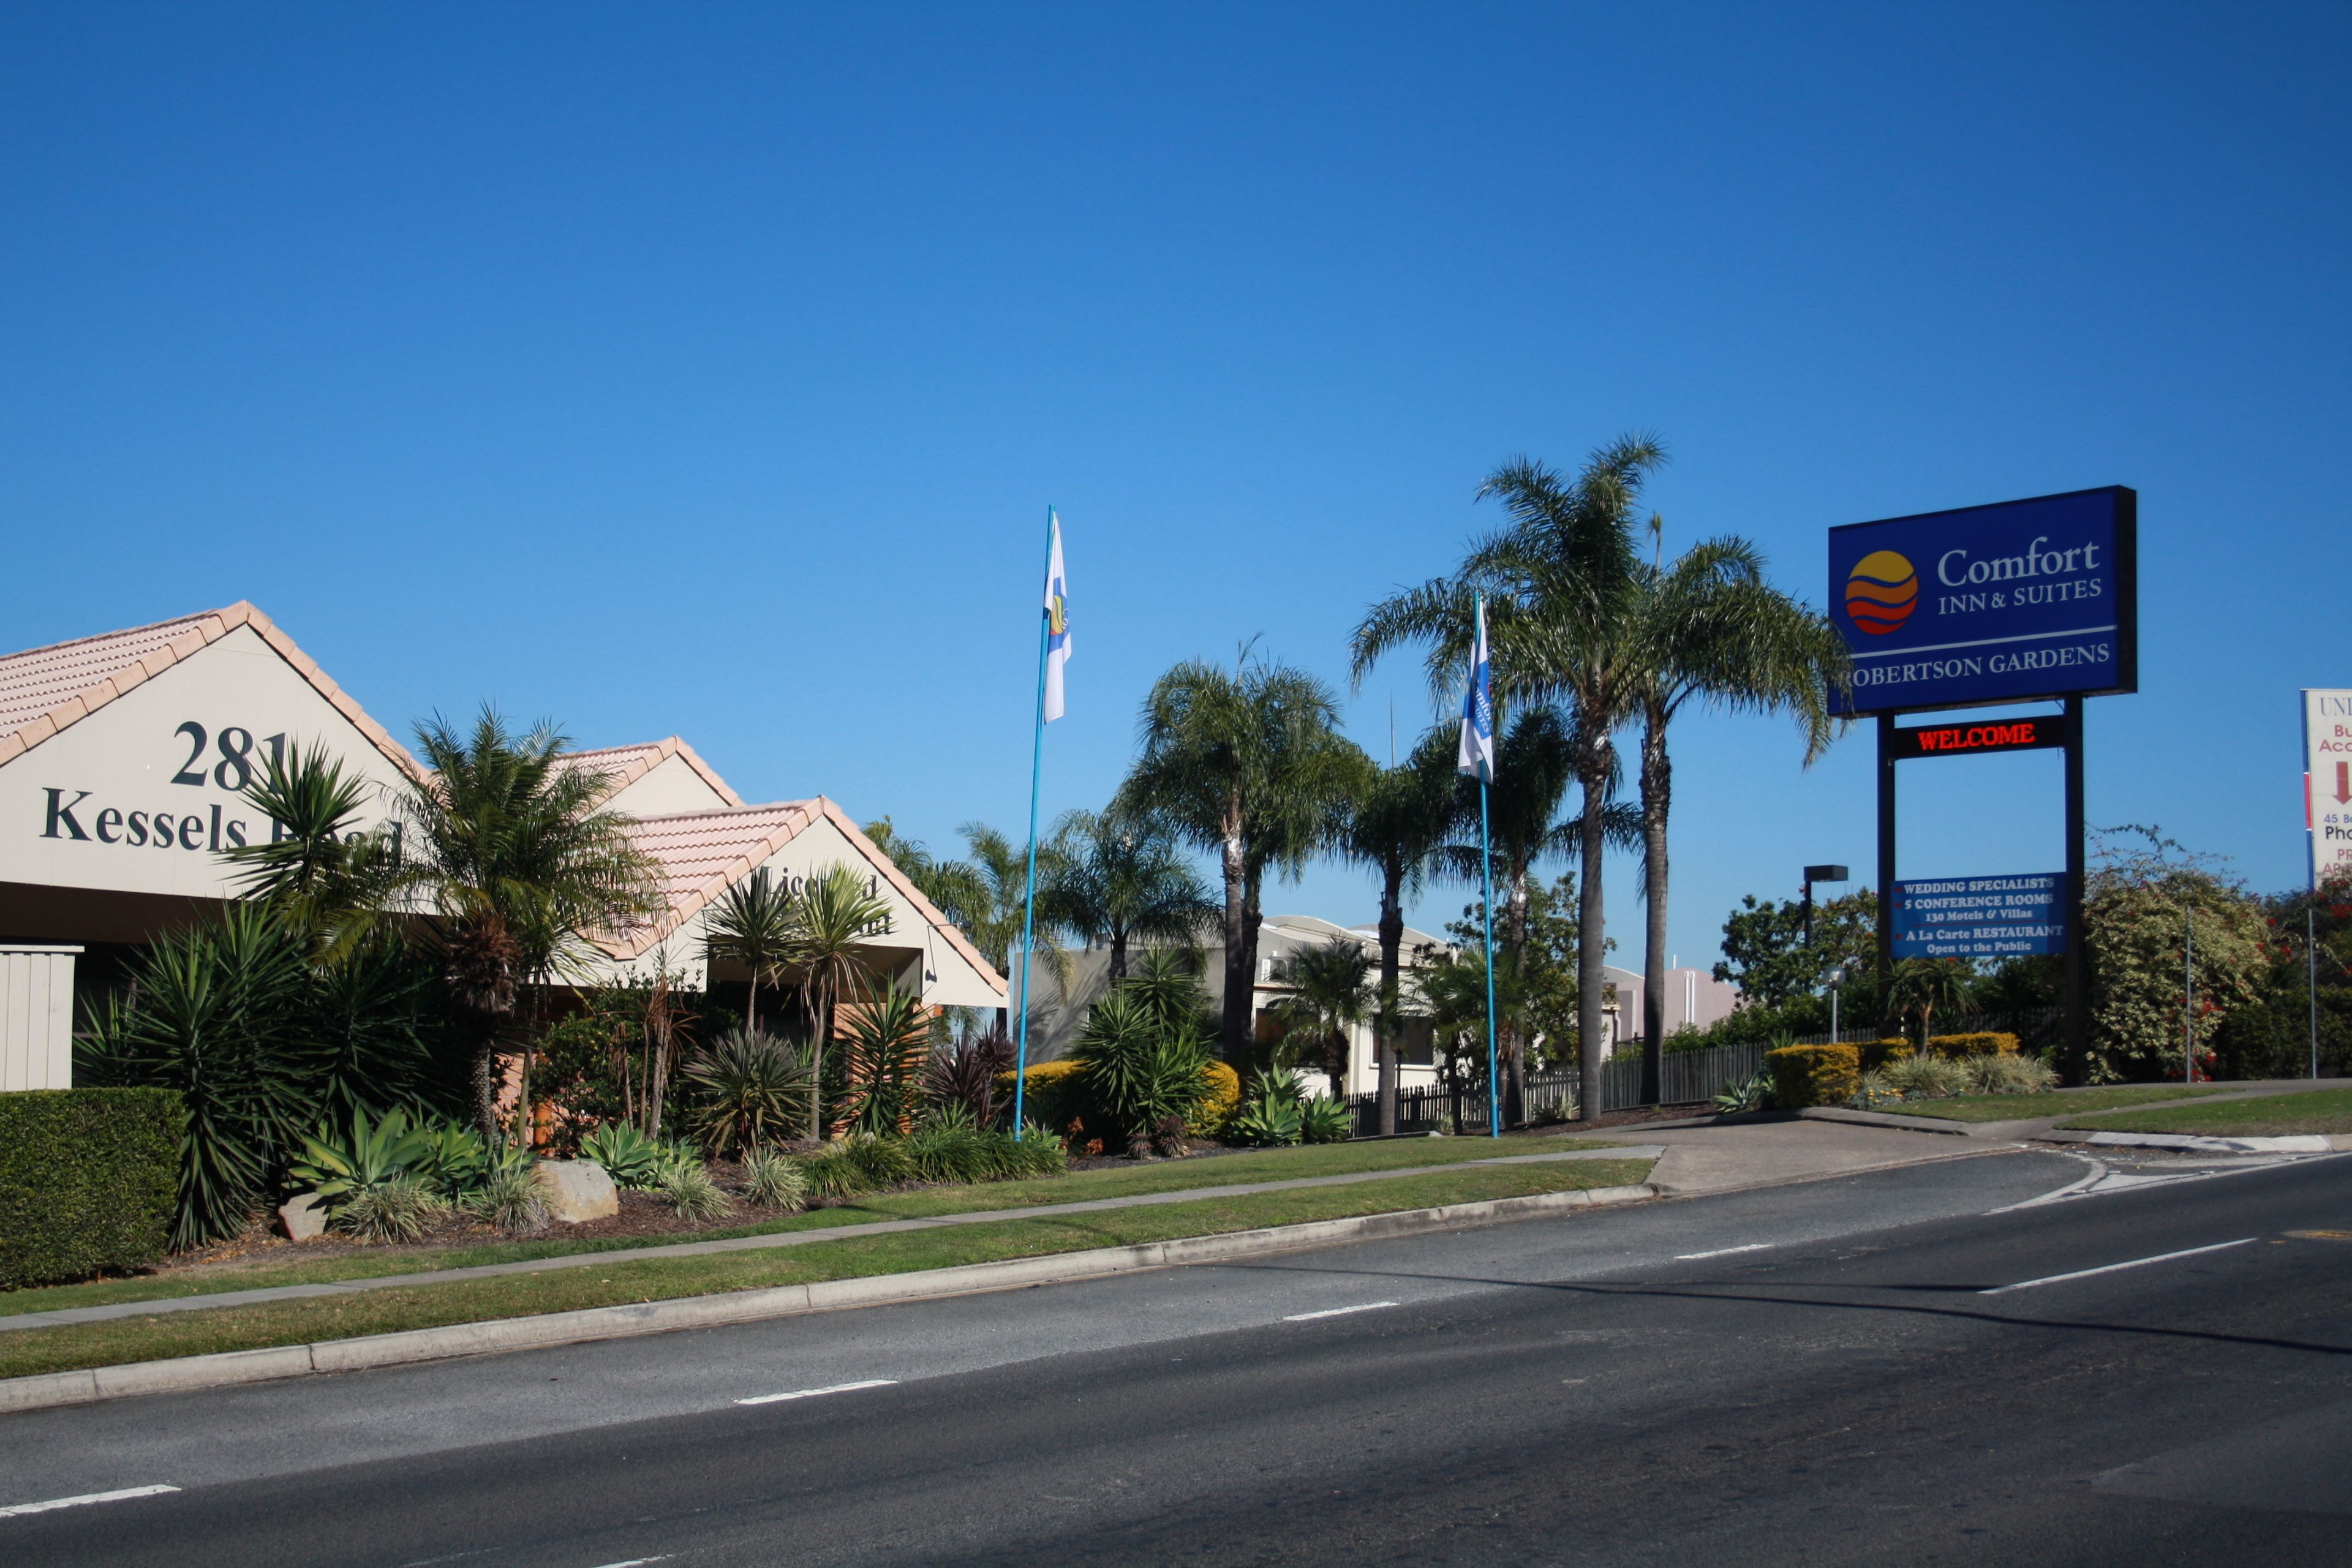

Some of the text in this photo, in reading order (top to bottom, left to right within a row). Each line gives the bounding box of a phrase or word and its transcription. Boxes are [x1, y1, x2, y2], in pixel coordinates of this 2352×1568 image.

[1937, 537, 2100, 587] Comfort
[1938, 578, 2102, 614] INN & SUITES
[1989, 643, 2109, 673] GARDENS
[1918, 723, 2036, 750] WELCOME
[170, 721, 287, 795] 281
[39, 787, 247, 853] Kessels
[2324, 814, 2352, 823] 45 B
[1904, 877, 2054, 894] WEDDING SPECIALISTS
[1904, 893, 2054, 910] 5 CONFERENCE ROOMS
[1925, 908, 2032, 922] 130 Motels & Villas
[1905, 925, 2063, 941] A La Carte RESTAURANT
[1926, 941, 2031, 955] Open to the Public
